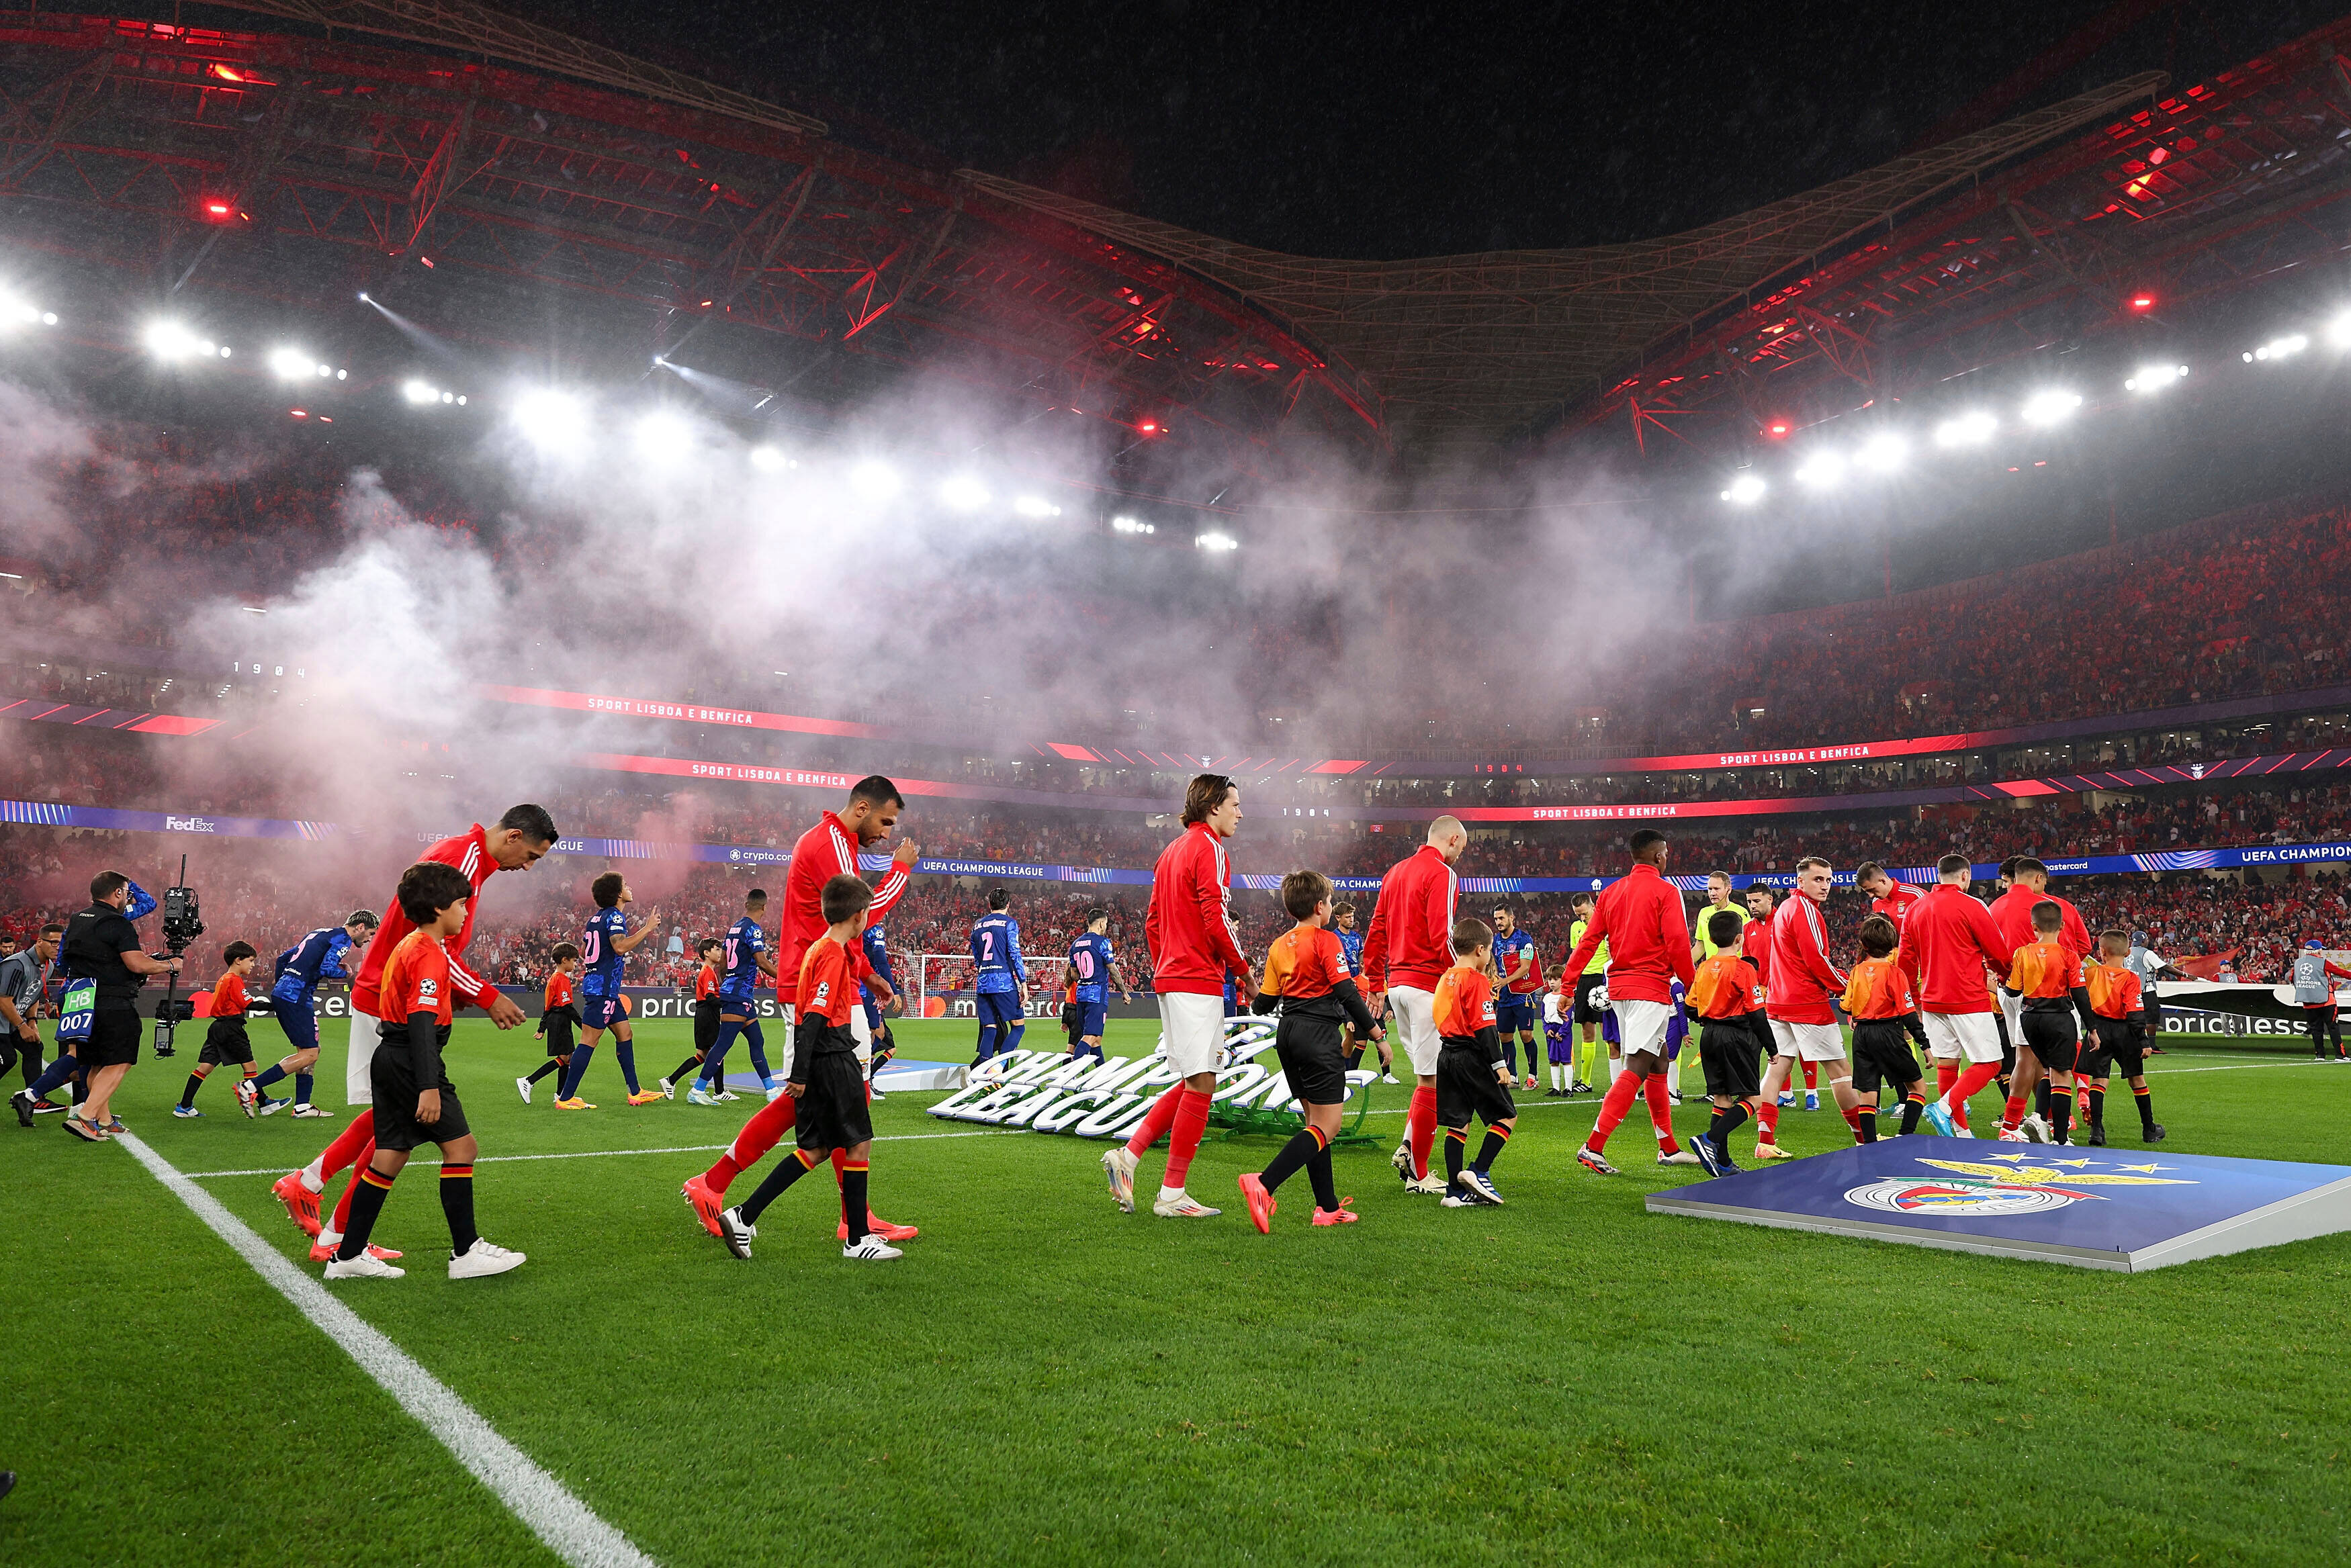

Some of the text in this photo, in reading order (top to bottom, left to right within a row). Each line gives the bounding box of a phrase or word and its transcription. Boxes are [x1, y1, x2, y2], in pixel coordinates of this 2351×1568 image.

[588, 698, 753, 725] SPORT LISBOA E BENFICA
[1720, 746, 1869, 765] SPORT LISBOA E BENFICA
[693, 764, 846, 786] SPORT LISBOA E BENFICA
[1534, 806, 1676, 819] SPORT LISBOA E BENFICA
[166, 816, 215, 832] FedEx
[416, 832, 450, 842] UEF
[550, 840, 584, 851] AGUE
[2242, 850, 2276, 862] UEFA
[923, 861, 1043, 876] UEFA CHAMPIONS LEAGUE
[1349, 880, 1382, 888] CHAMP
[981, 931, 993, 961] 2
[1073, 950, 1094, 979] 10
[69, 990, 91, 1009] HB
[603, 1000, 616, 1015] 20
[60, 1013, 93, 1031] 007
[925, 1080, 1161, 1140] LEAGU
